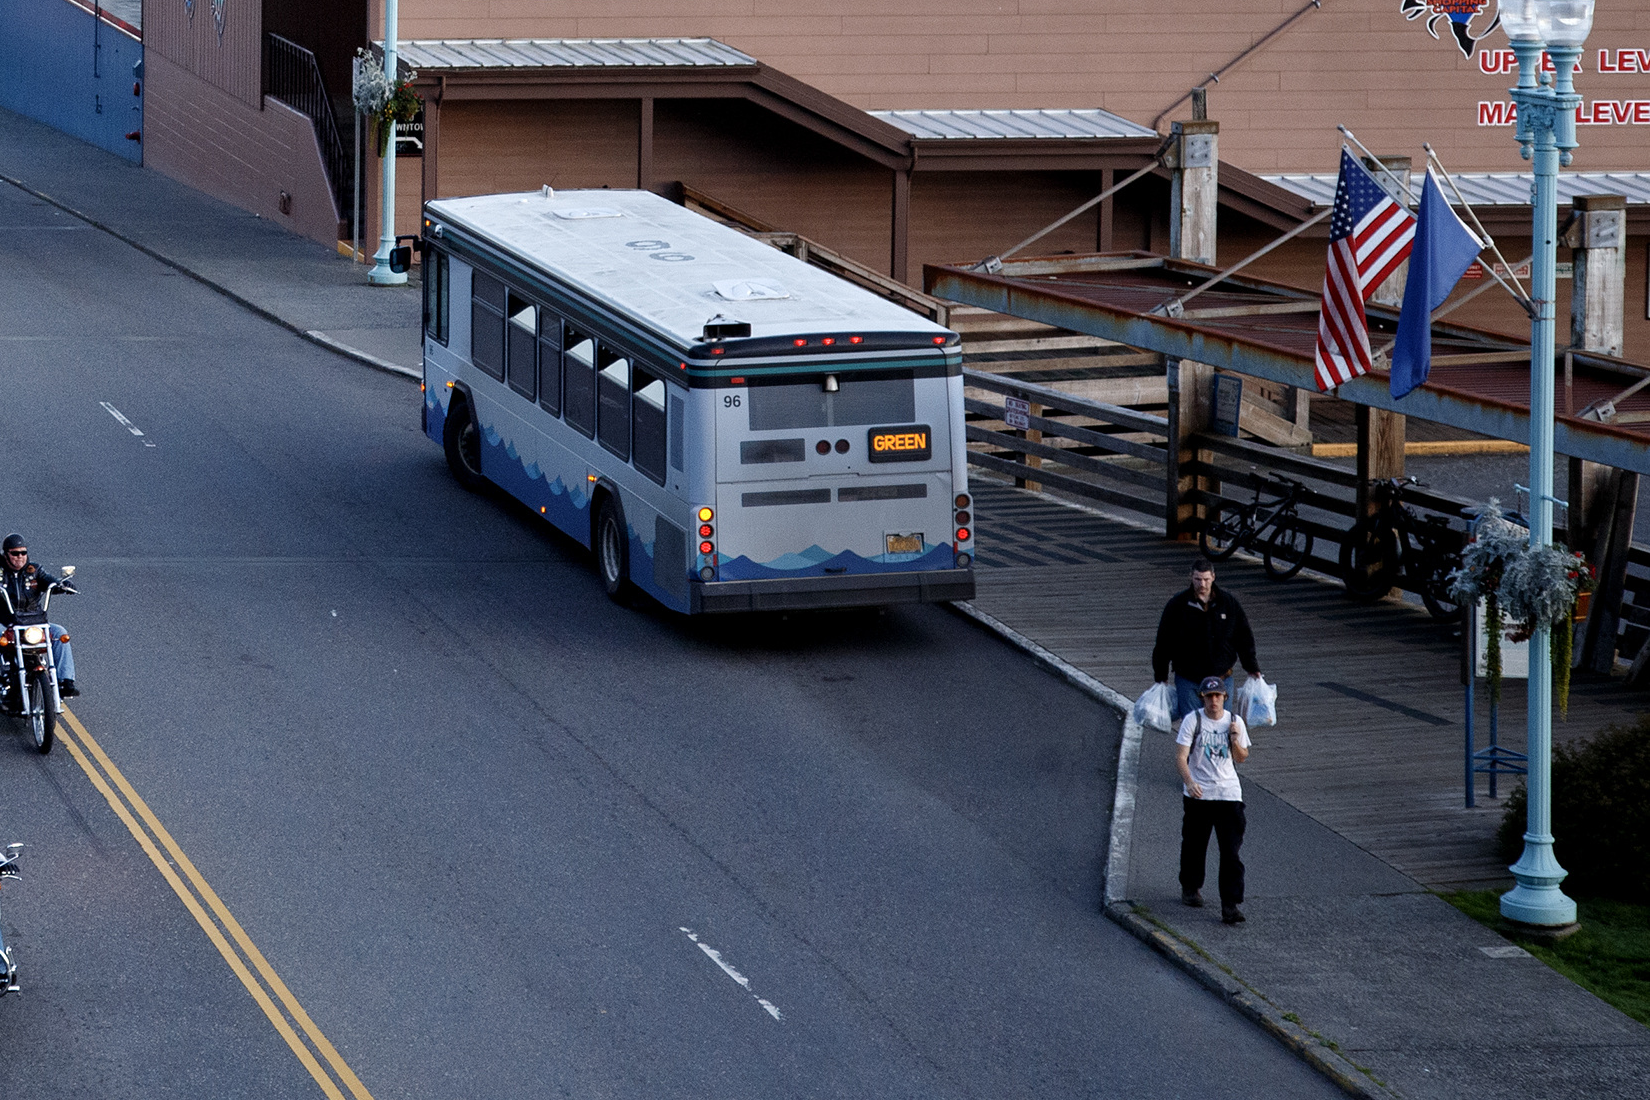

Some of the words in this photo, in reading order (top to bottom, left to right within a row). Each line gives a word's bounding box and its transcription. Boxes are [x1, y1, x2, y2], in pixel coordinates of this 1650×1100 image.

[1433, 4, 1482, 14] CAPITAL
[1480, 50, 1582, 73] UPE
[1478, 102, 1517, 125] MA
[396, 122, 424, 132] WNTO
[723, 394, 742, 408] 96
[873, 432, 927, 452] GREEN
